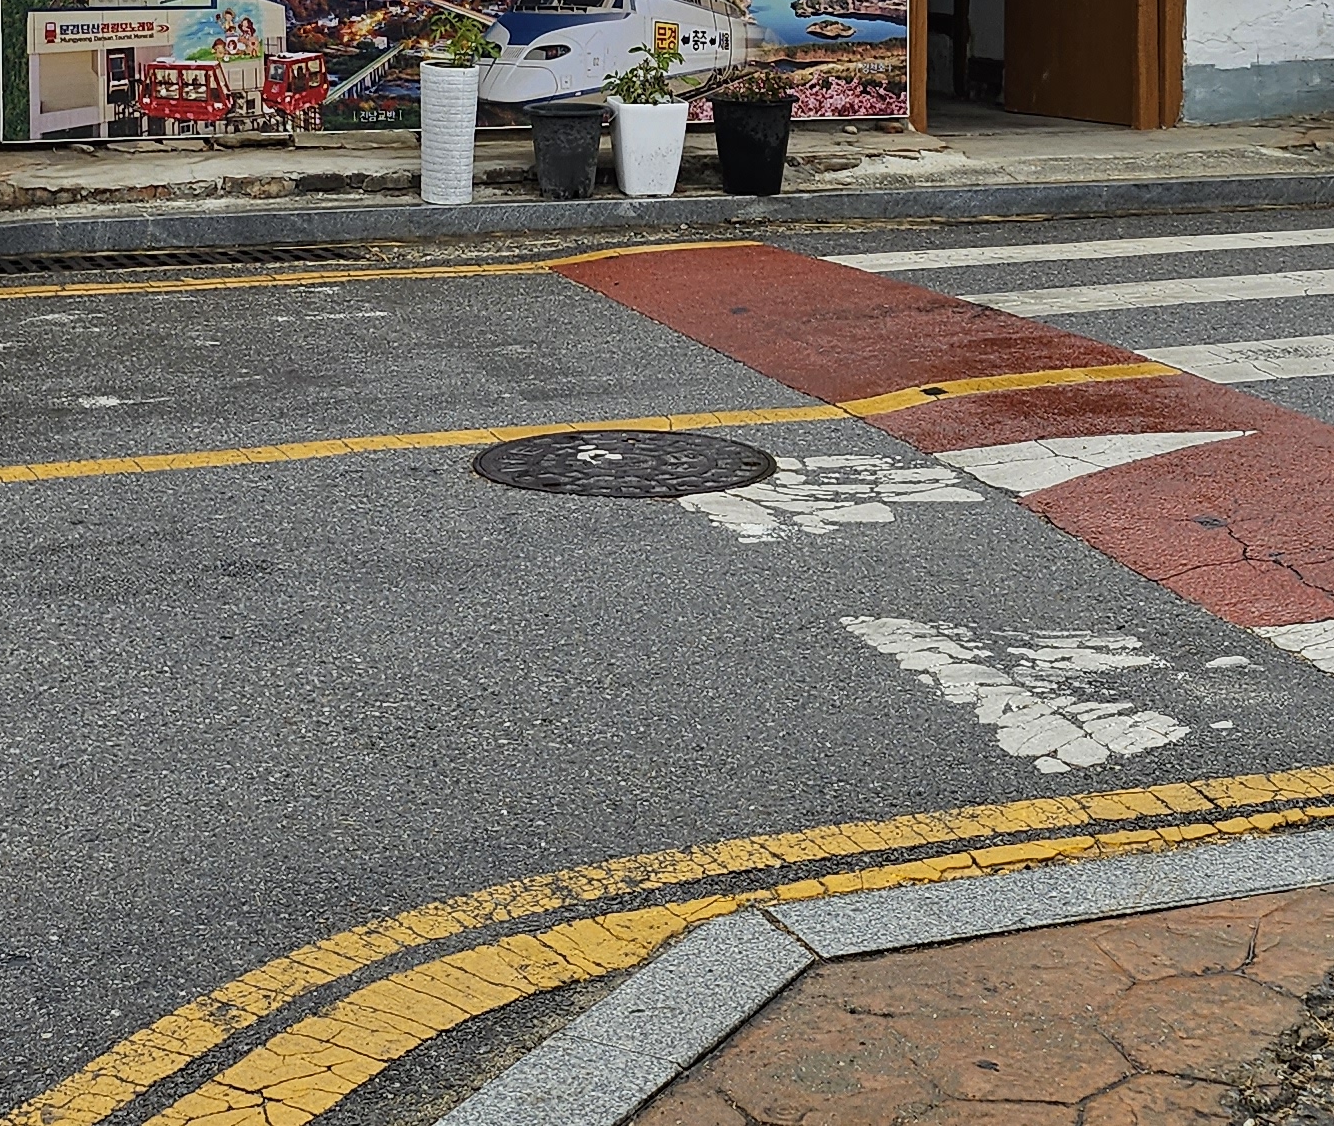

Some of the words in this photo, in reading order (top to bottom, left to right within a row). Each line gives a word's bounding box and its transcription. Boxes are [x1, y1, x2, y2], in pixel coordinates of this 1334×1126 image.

[656, 26, 677, 50] 문경
[692, 30, 708, 52] 충주
[359, 110, 396, 122] 진남교반
